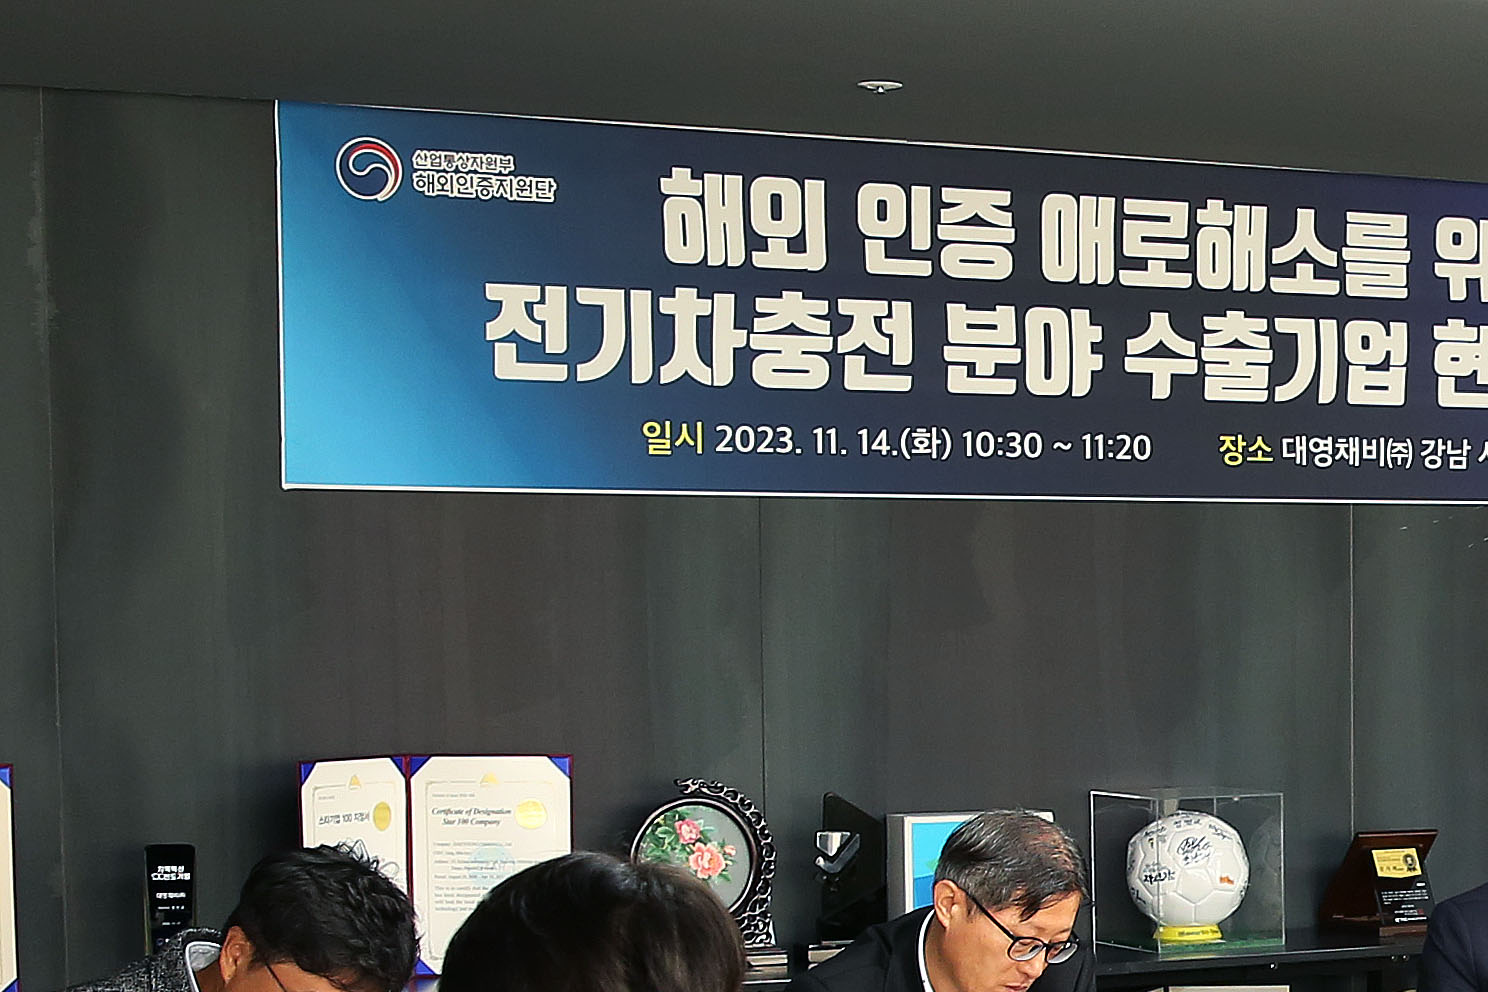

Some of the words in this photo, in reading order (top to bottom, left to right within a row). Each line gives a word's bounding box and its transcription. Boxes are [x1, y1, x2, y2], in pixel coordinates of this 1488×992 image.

[412, 149, 515, 175] 산업통상자원부
[412, 172, 557, 203] 해외인증지원단
[658, 165, 828, 272] 해외
[856, 181, 1017, 281] 인증
[1040, 192, 1412, 300] 애로해소를
[484, 282, 915, 393] 전기차충전
[942, 302, 1104, 398] 분야
[1123, 309, 1409, 407] 수출기업
[642, 420, 704, 456] 일시
[715, 425, 803, 455] 2023.
[812, 427, 848, 456] 11.
[857, 426, 953, 460] 14.(화)
[962, 430, 1043, 459] 10:30
[1052, 441, 1073, 451] ~
[1081, 433, 1152, 461] 11:20
[1219, 434, 1274, 466] 장소
[1420, 438, 1472, 470] 강남
